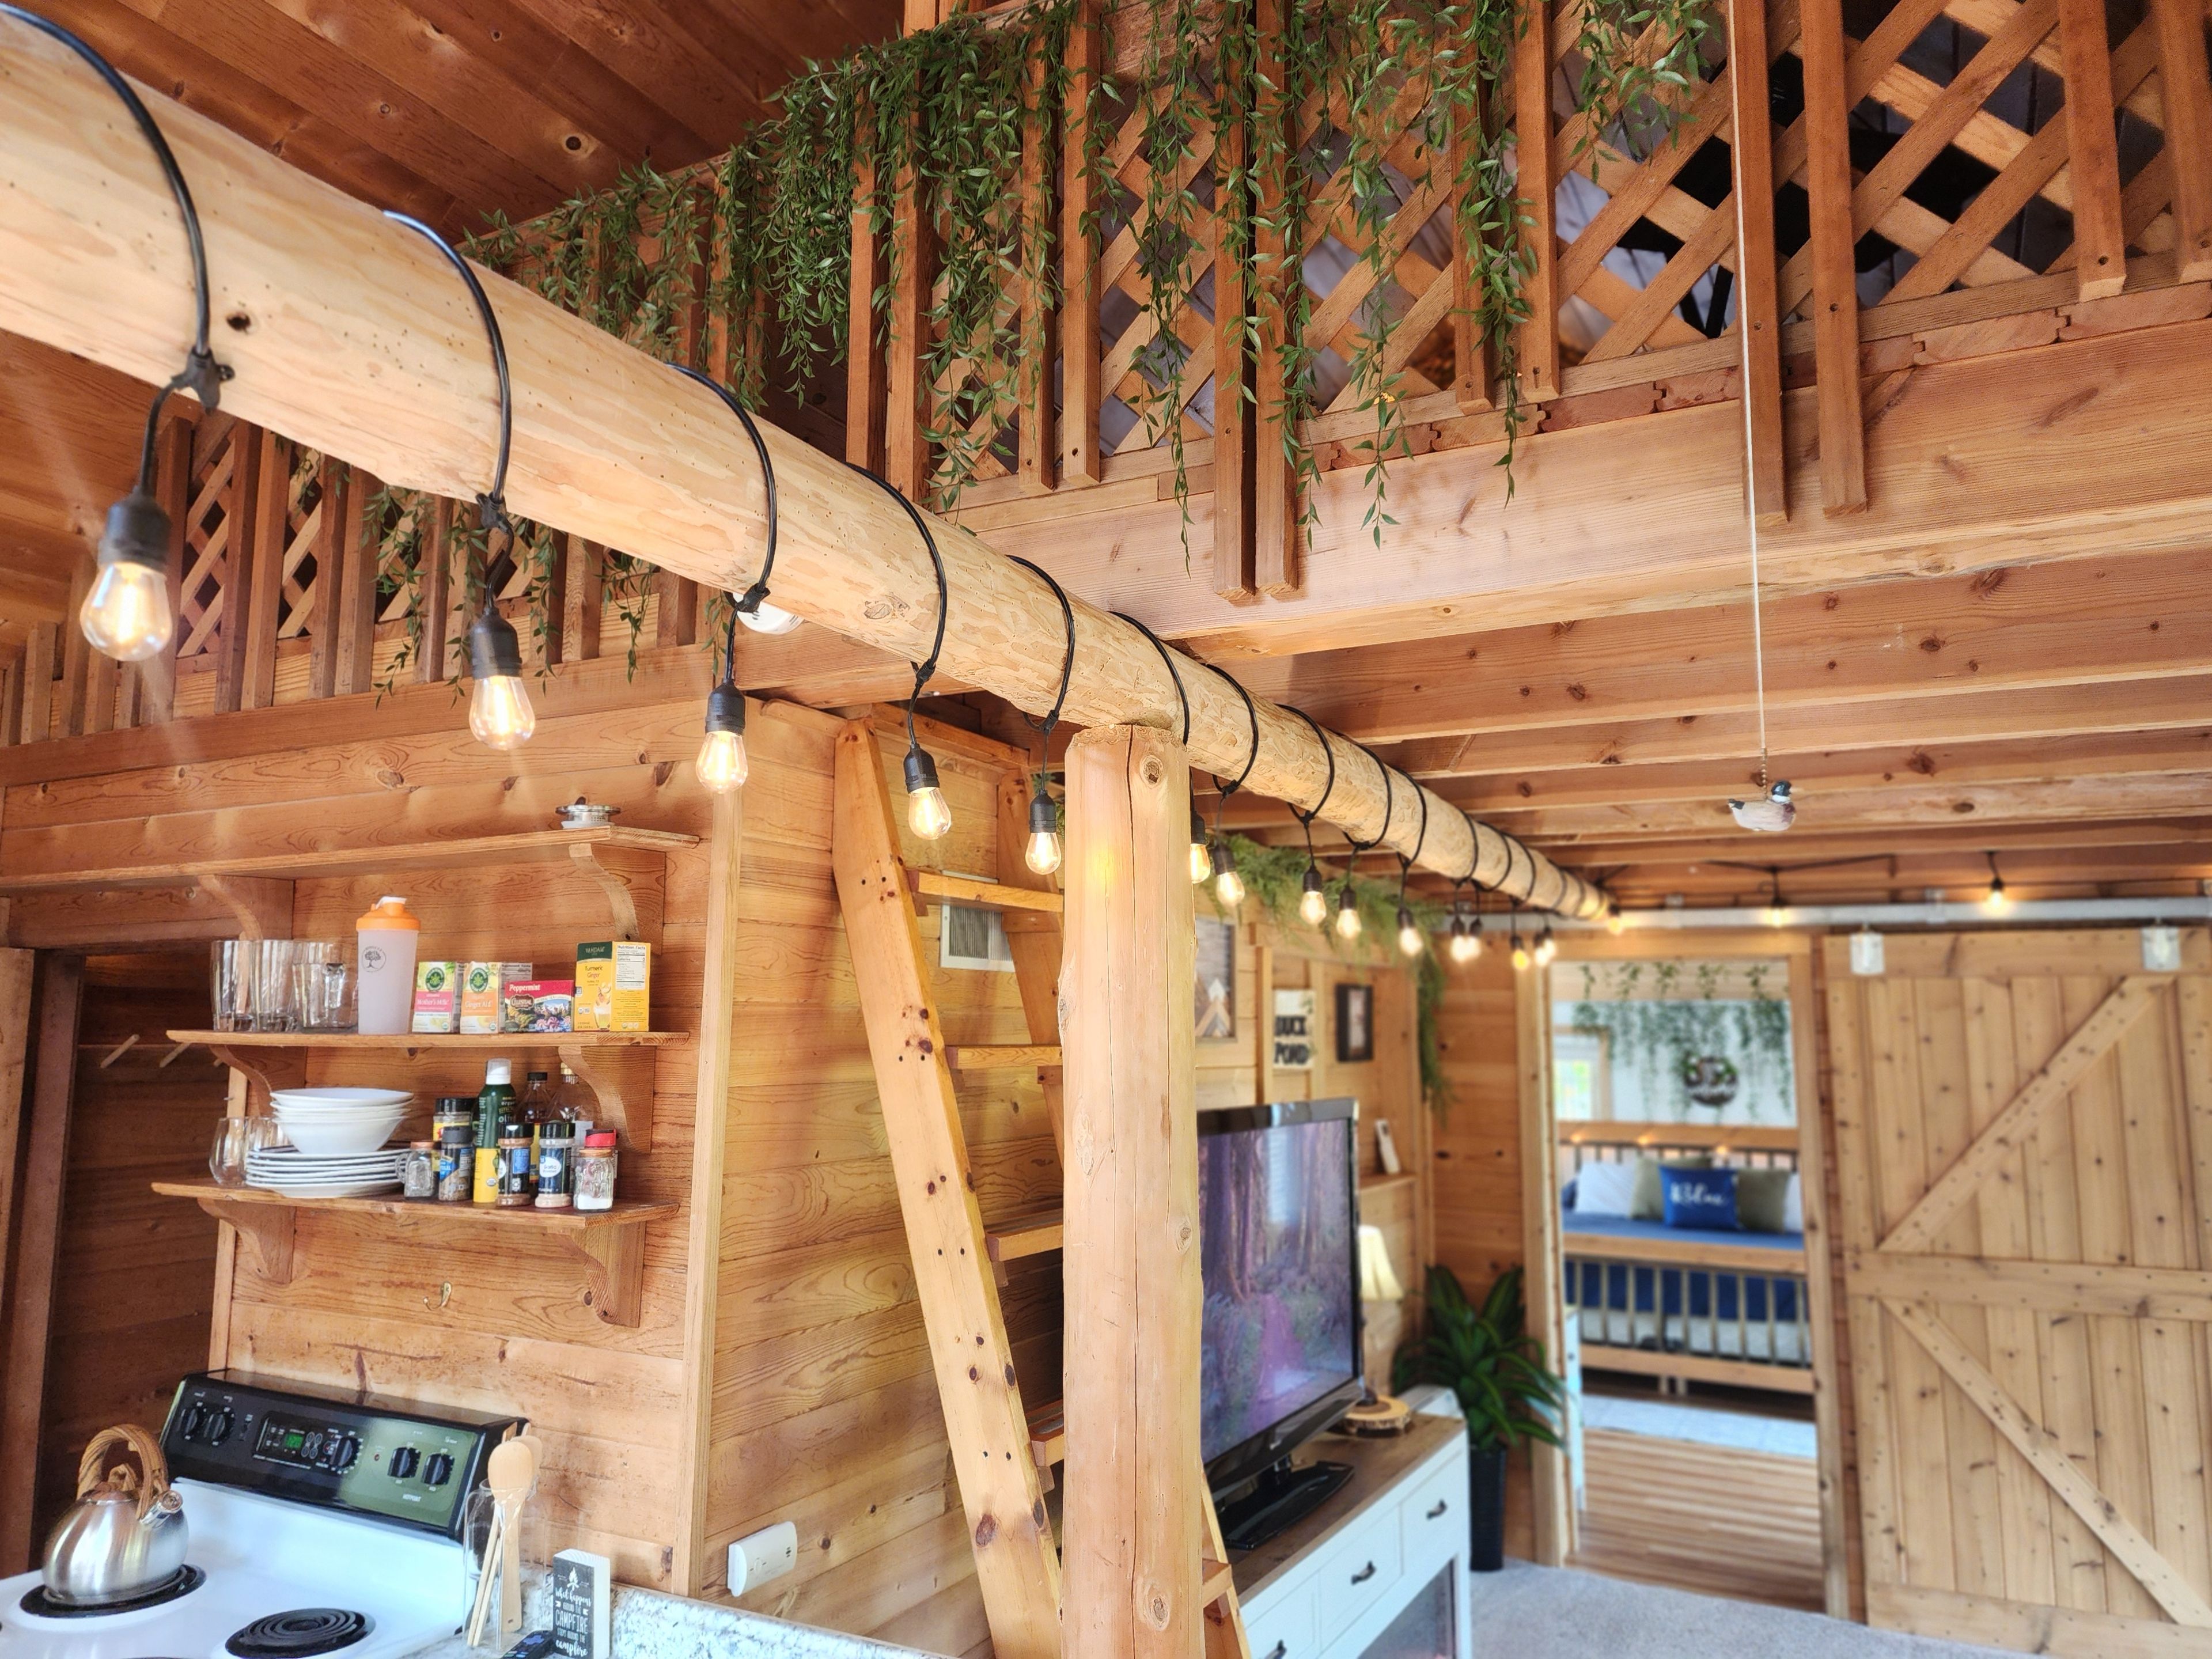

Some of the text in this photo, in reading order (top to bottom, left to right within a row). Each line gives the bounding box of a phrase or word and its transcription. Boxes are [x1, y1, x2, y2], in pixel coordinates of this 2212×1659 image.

[509, 984, 541, 993] Peppermint
[465, 1001, 480, 1009] Ginger
[555, 1609, 588, 1634] CAMPFIRE
[555, 1639, 588, 1657] campfire
